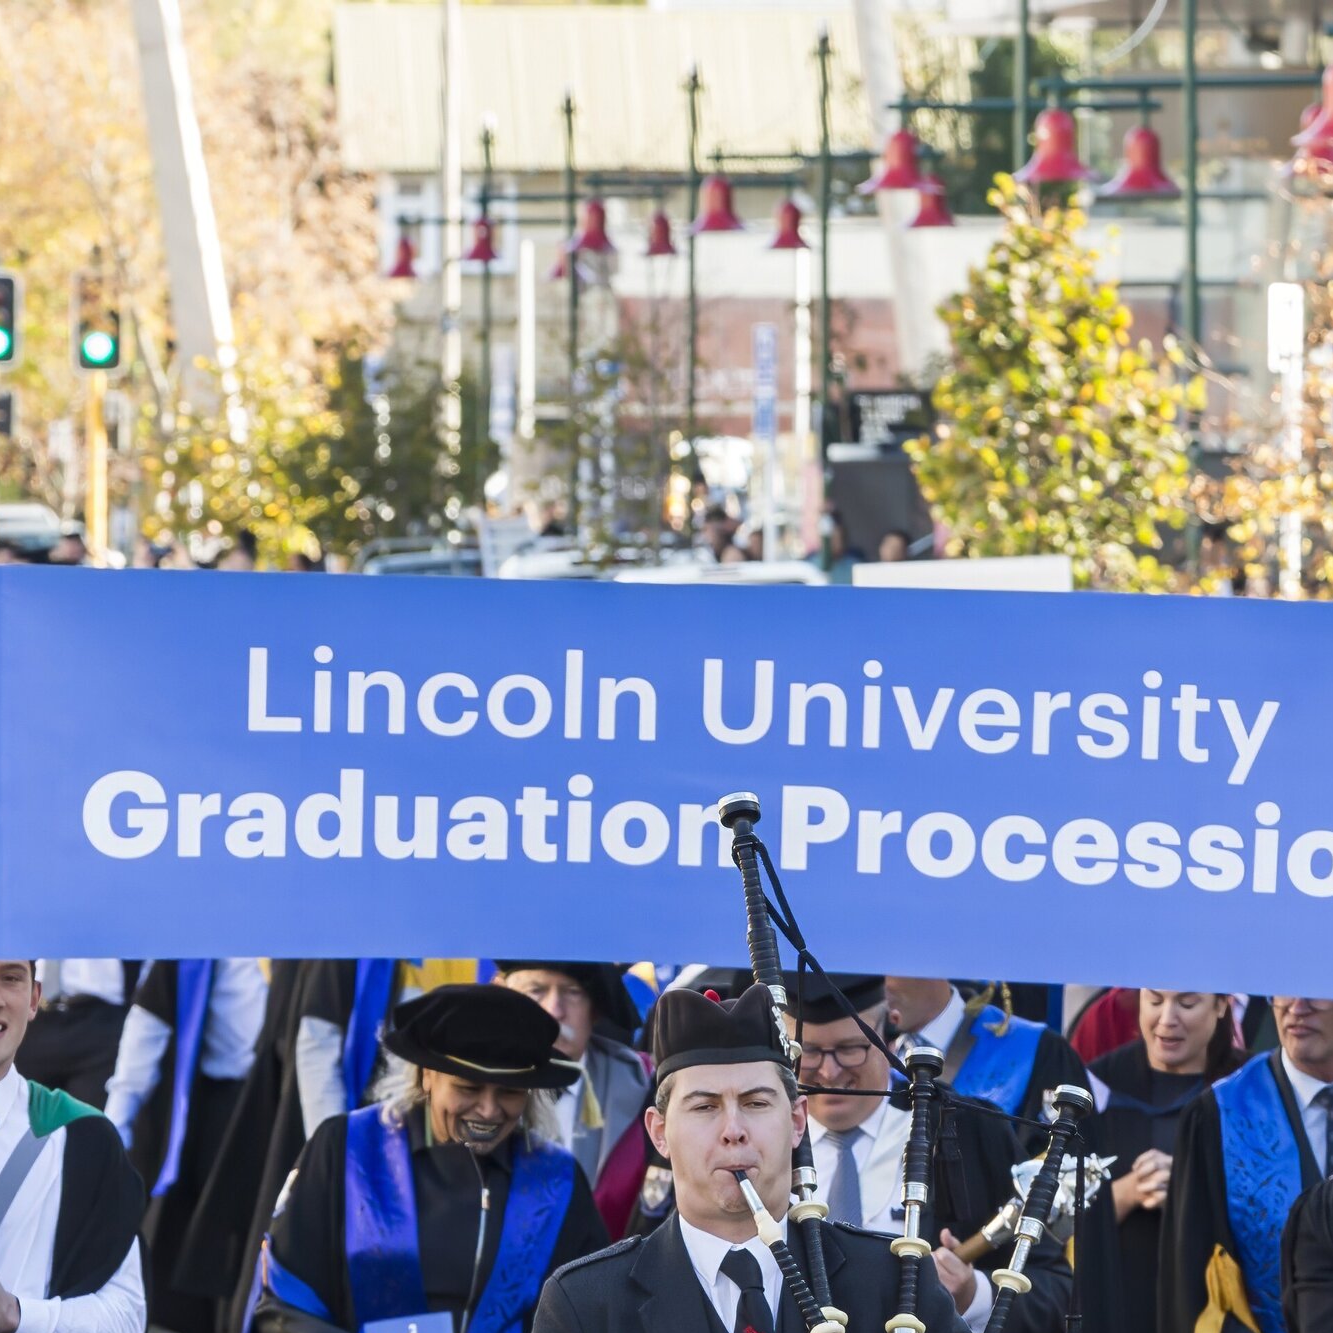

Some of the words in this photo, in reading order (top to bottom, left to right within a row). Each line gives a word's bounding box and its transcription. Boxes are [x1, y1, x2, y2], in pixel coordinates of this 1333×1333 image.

[247, 645, 658, 742] Lincoln
[702, 656, 1282, 787] University
[81, 767, 737, 868] Graduation
